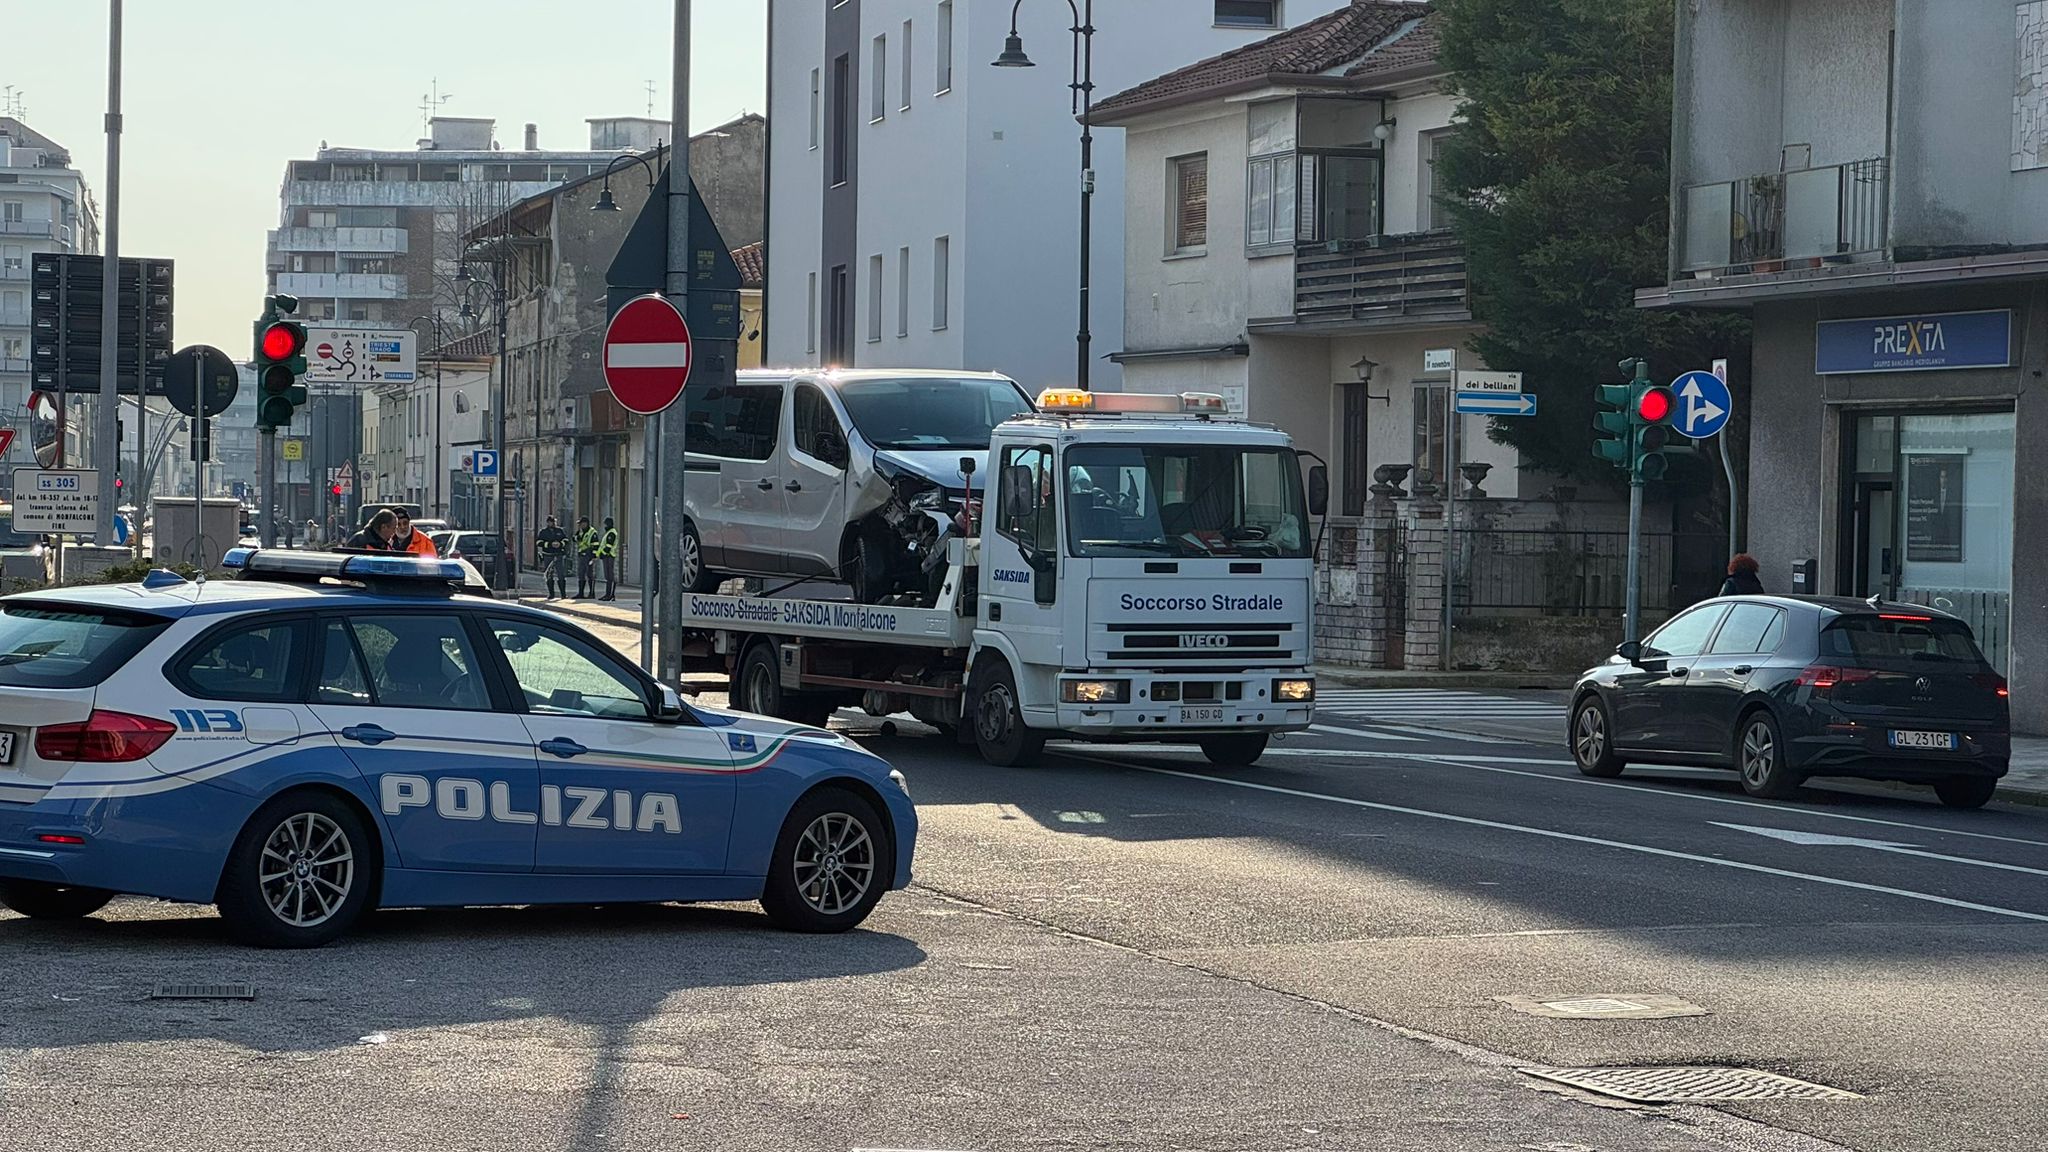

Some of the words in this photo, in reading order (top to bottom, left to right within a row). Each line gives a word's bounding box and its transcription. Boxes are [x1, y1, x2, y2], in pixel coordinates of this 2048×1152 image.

[1874, 321, 1945, 356] PREXTA
[1465, 381, 1480, 389] dei
[1483, 382, 1517, 390] belliani
[42, 480, 52, 488] ss
[56, 478, 75, 488] 305
[993, 568, 1030, 584] SAKSIDA
[1120, 593, 1206, 611] Soccorso
[1211, 593, 1283, 611] Stradale
[691, 595, 735, 618] Soccorso
[783, 603, 831, 626] SAKSIDA
[833, 607, 897, 631] Monfalcone
[1178, 634, 1229, 648] IVECO
[169, 709, 243, 732] 113
[1181, 710, 1191, 719] BA
[1195, 710, 1210, 719] 150
[1896, 732, 1911, 744] GL
[380, 773, 683, 834] POLIZIA
